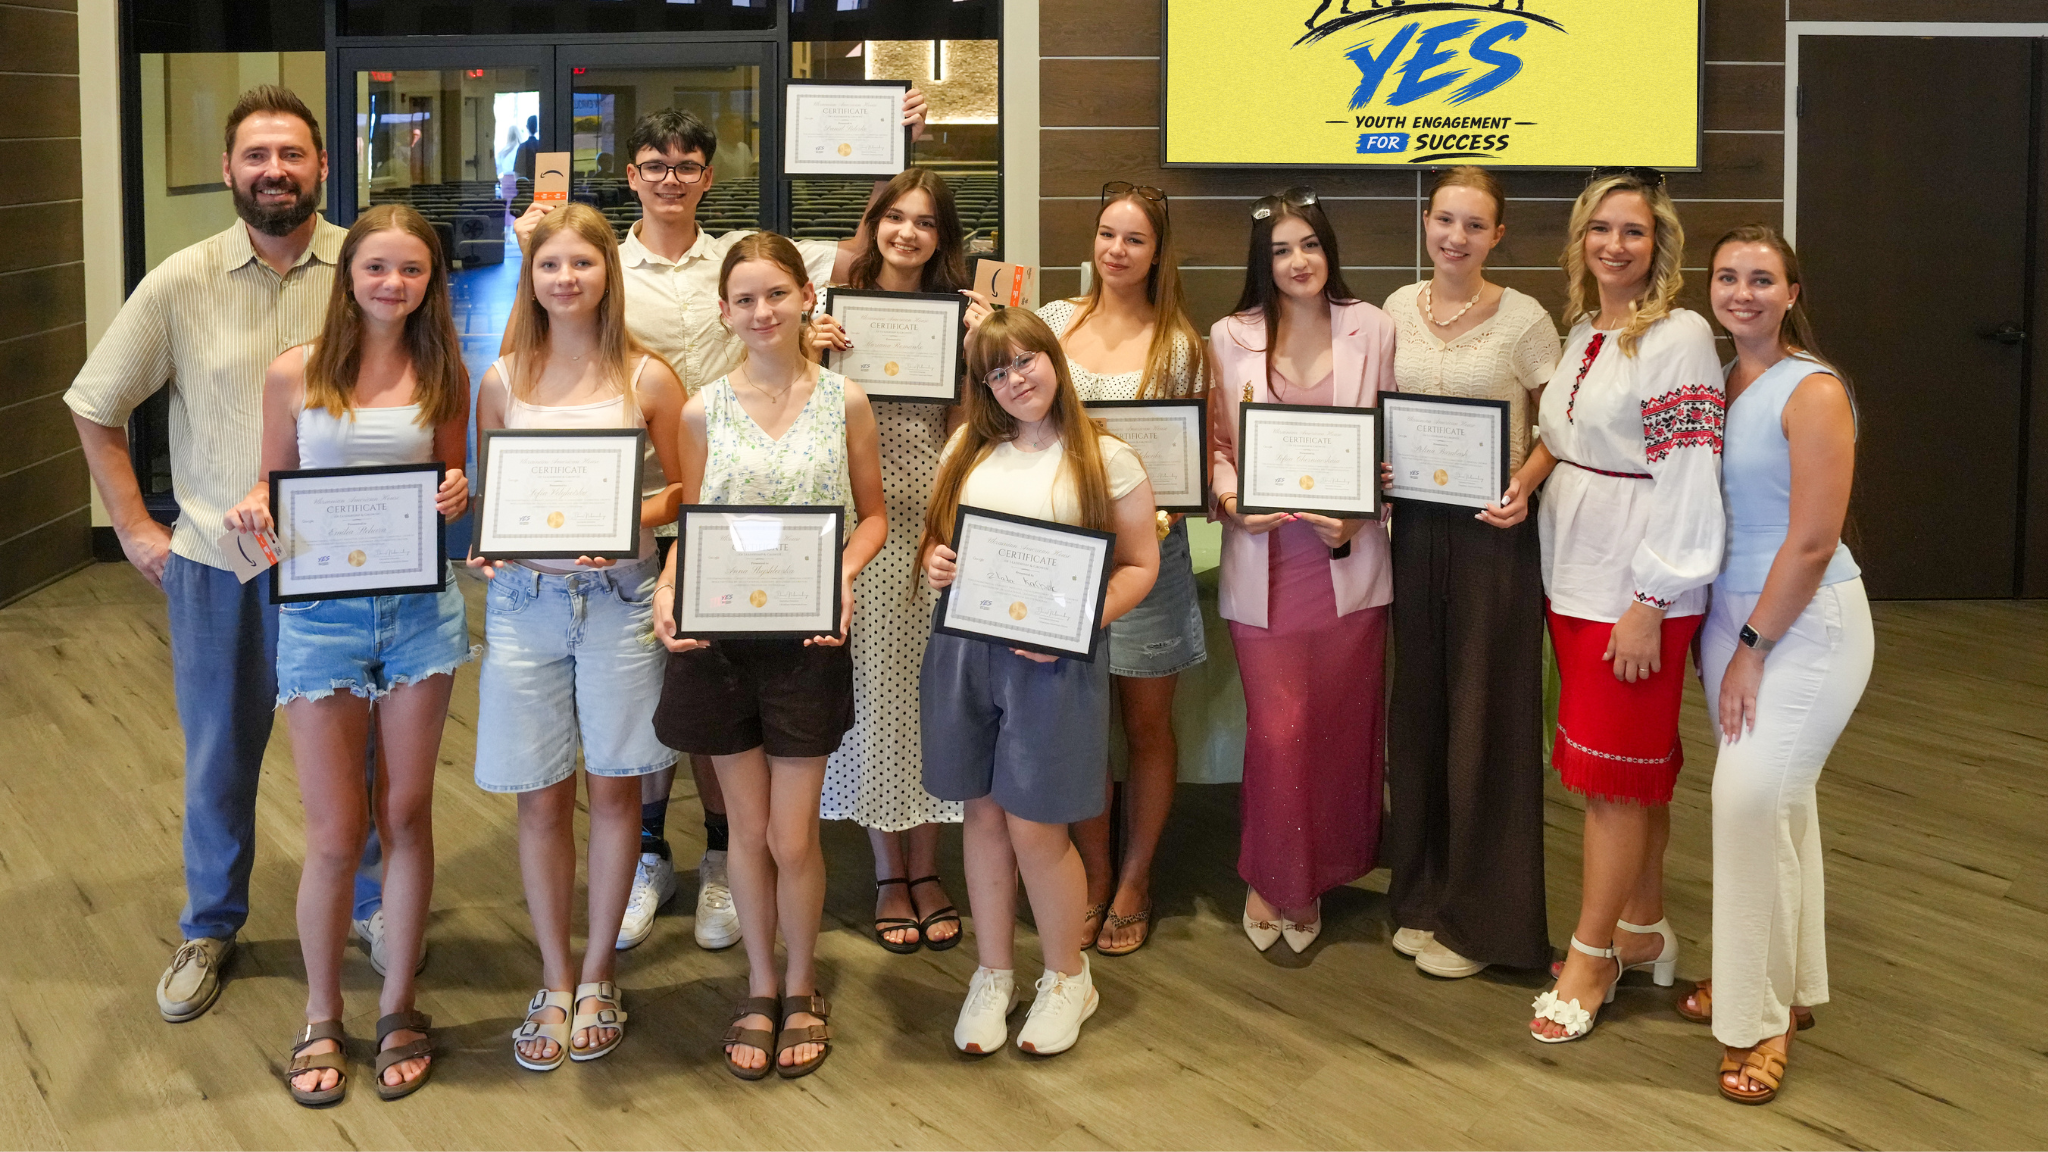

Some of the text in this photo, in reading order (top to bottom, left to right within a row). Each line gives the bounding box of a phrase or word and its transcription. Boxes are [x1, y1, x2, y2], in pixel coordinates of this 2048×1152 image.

[1343, 18, 1528, 112] YES
[822, 107, 868, 115] CERTIFICATE
[1355, 116, 1512, 130] YOUTH ENGAGEMENT
[1366, 134, 1510, 152] FOR SUCCESS
[870, 321, 919, 331] CERTIFICATE
[1416, 424, 1466, 436] CERTIFICATE
[1282, 436, 1332, 444] CERTIFICATE
[531, 466, 588, 474] CERTIFICATE
[326, 502, 387, 514] CERTIFICATE
[998, 548, 1058, 566] CERTIFICATE
